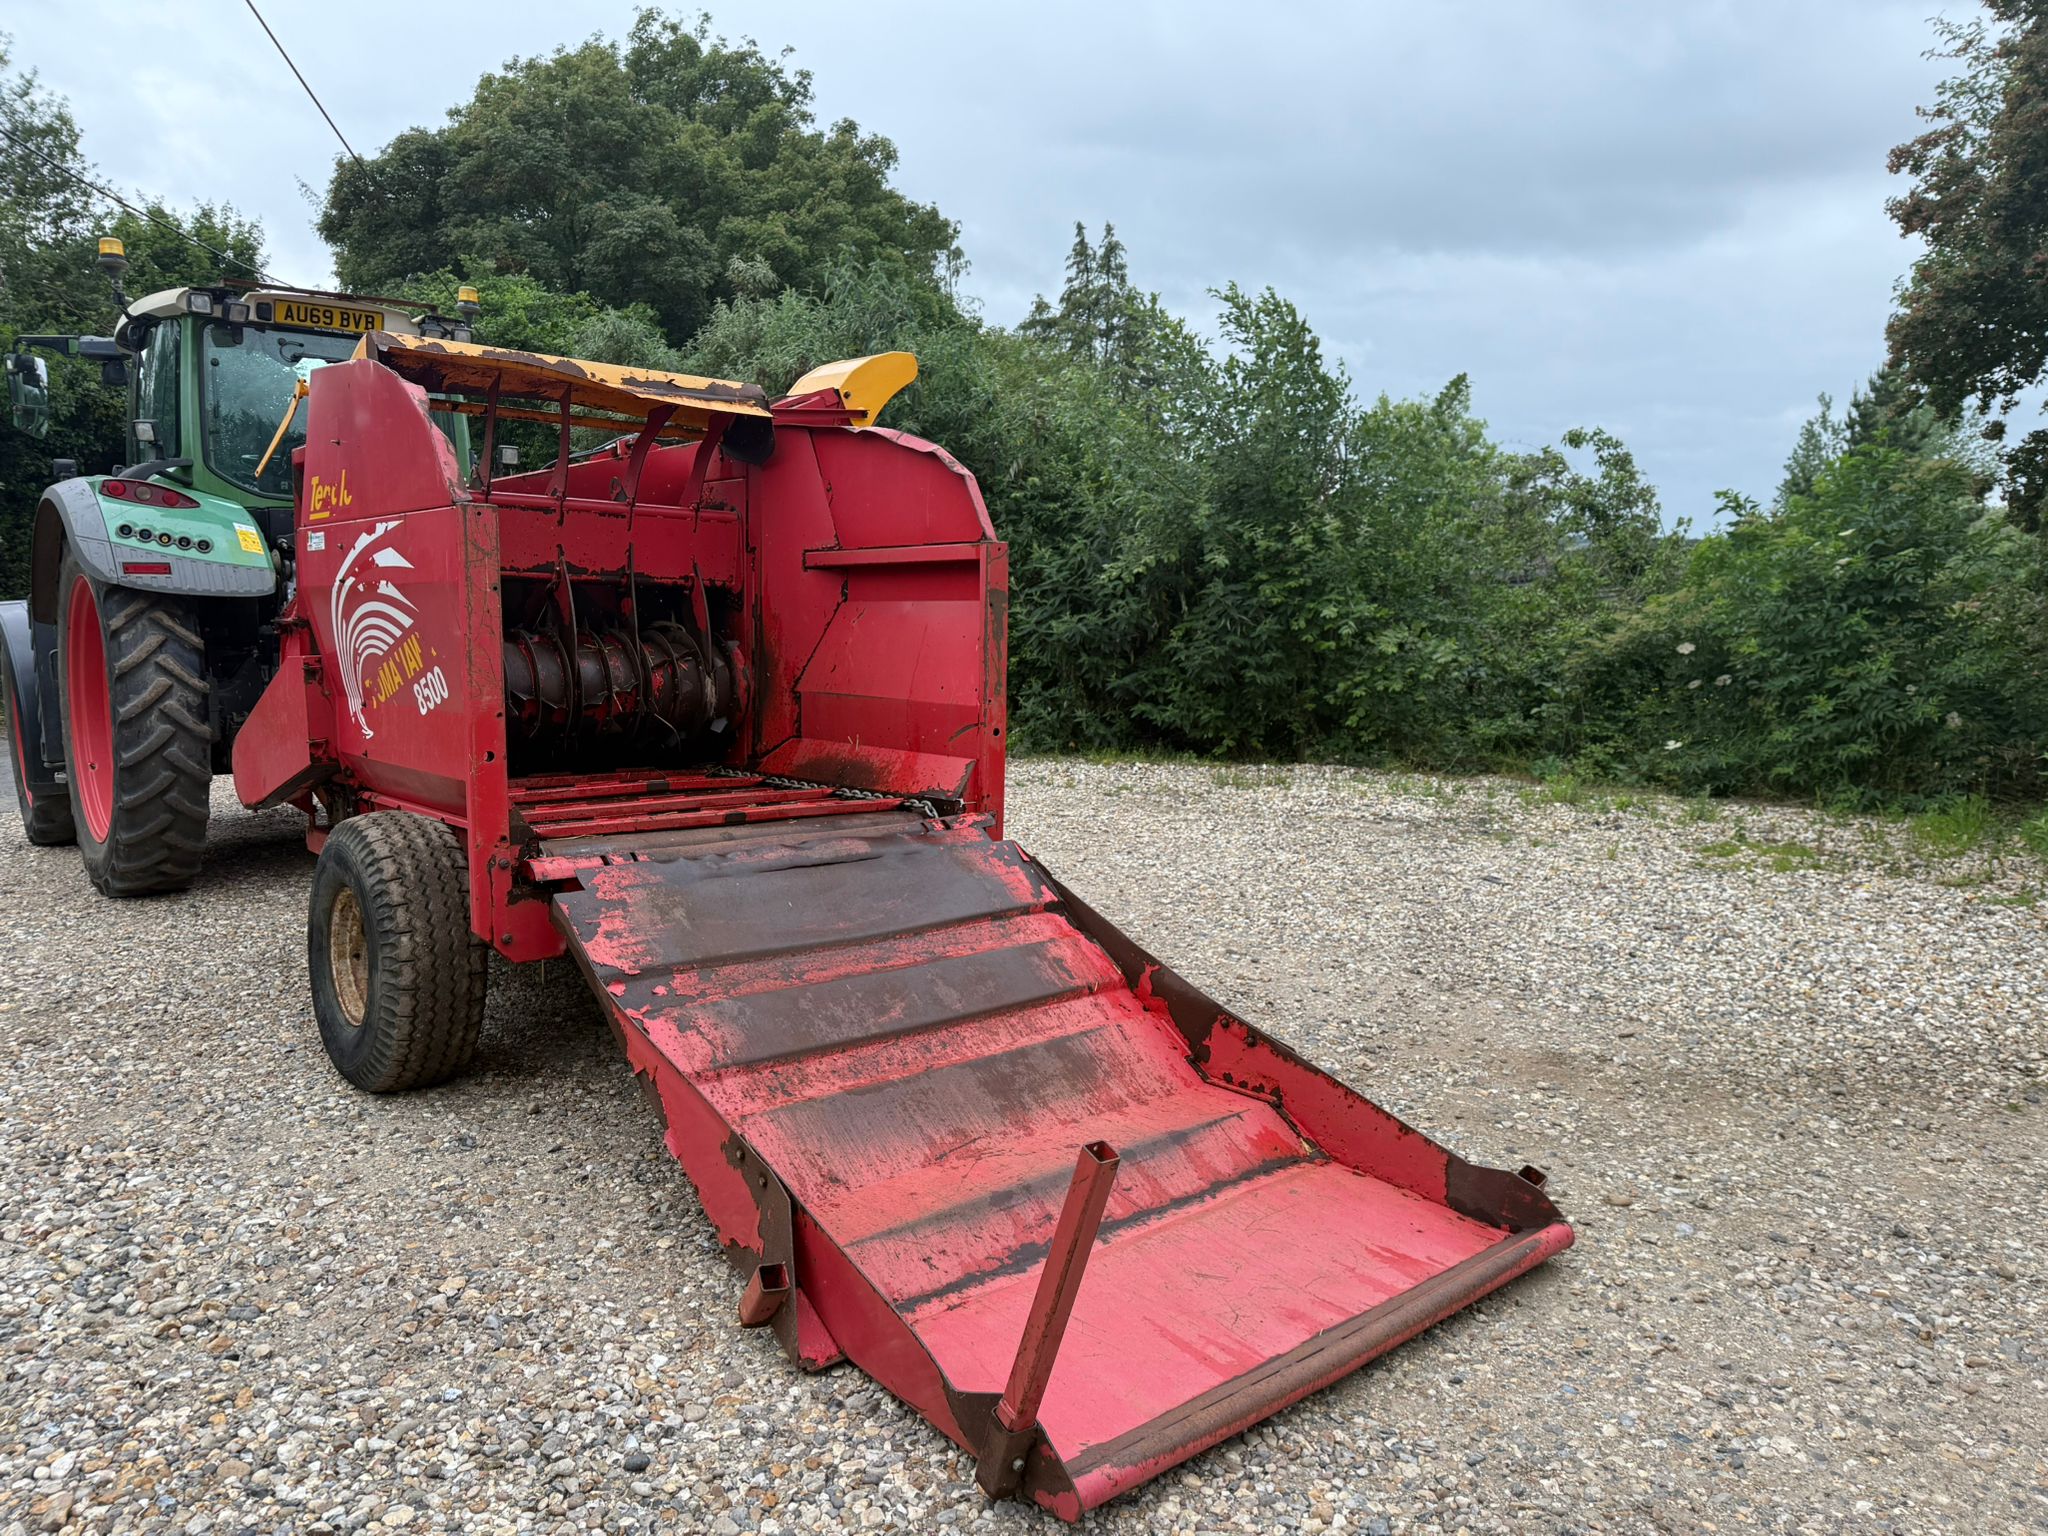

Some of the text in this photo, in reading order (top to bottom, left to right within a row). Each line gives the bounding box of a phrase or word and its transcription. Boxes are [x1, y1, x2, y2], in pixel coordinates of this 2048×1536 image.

[284, 304, 376, 331] AU69 BVB
[413, 665, 449, 716] 8500
